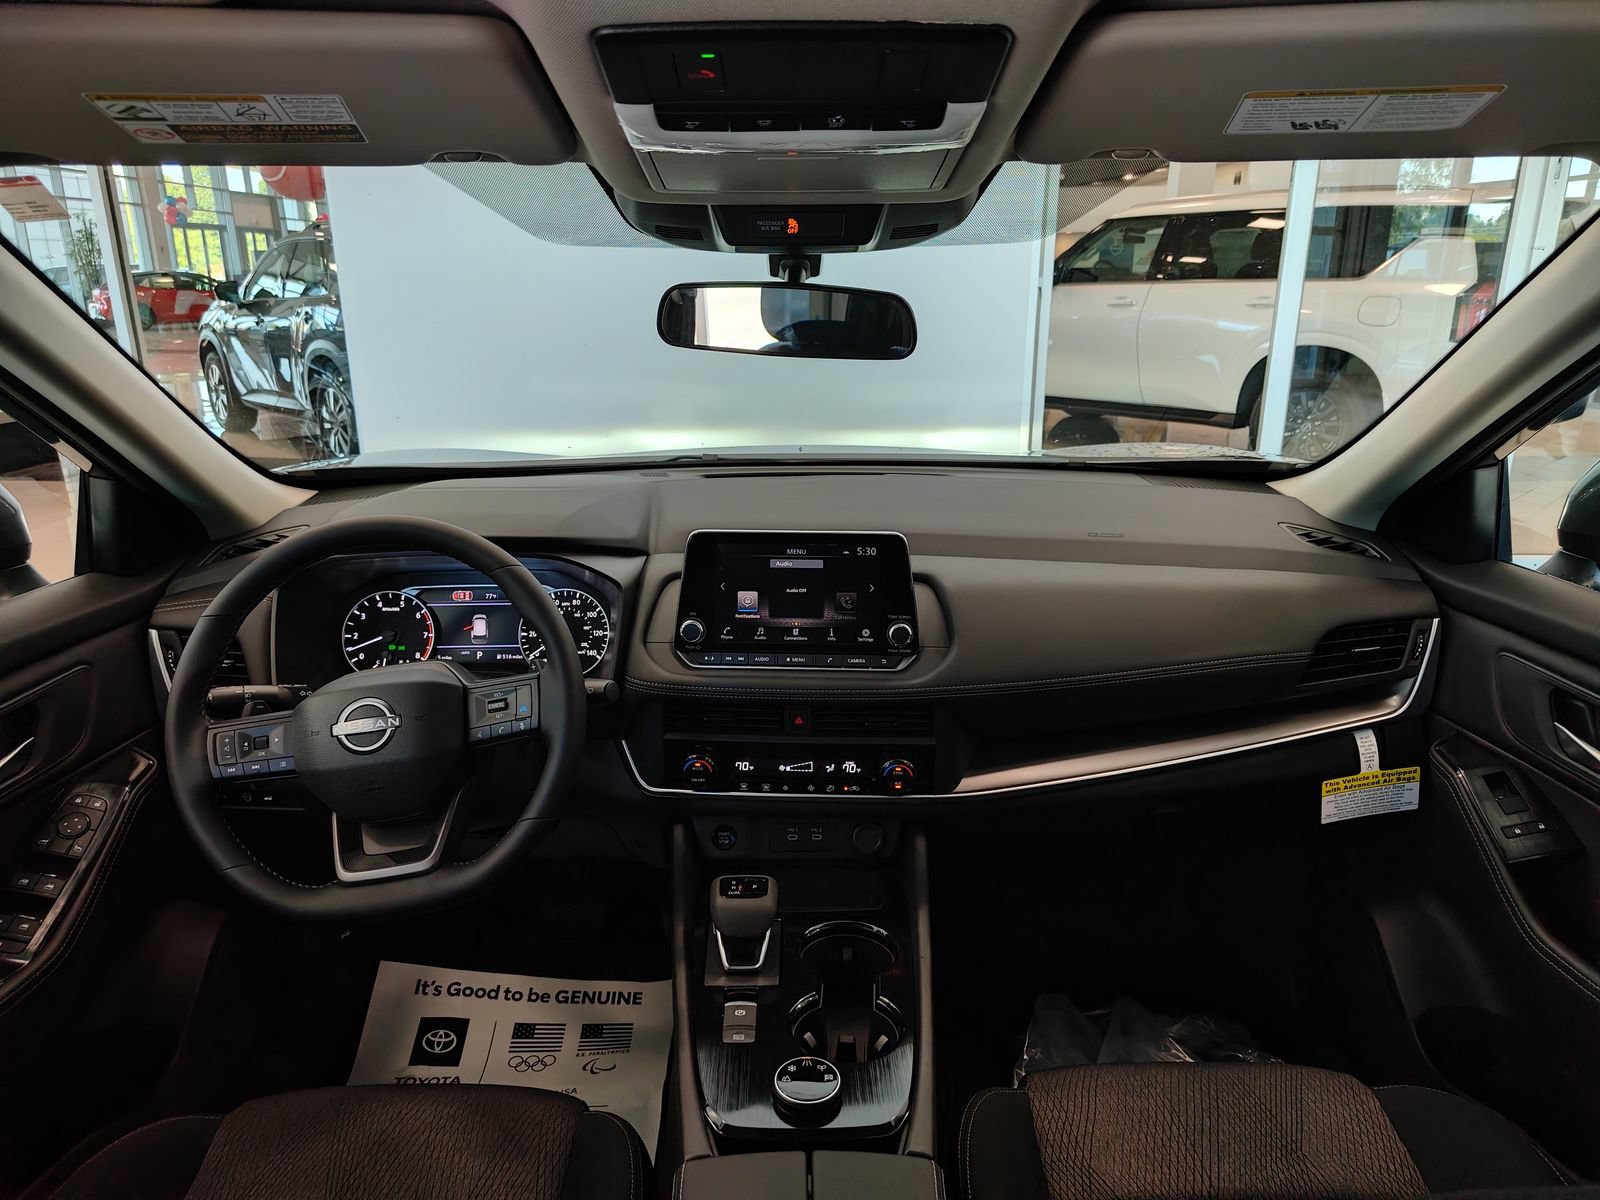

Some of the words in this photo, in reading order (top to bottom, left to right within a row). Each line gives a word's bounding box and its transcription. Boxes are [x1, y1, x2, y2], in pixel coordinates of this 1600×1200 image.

[857, 547, 877, 556] 5:30
[477, 651, 483, 659] P
[334, 717, 399, 736] NISSAN
[1342, 776, 1370, 784] Vehicle
[1381, 768, 1417, 777] Equipped
[1344, 780, 1380, 790] Advanced
[414, 978, 442, 996] It's
[446, 981, 500, 1000] Good
[504, 987, 523, 1001] to
[527, 987, 551, 1003] be
[555, 990, 643, 1005] GENUINE
[395, 1076, 461, 1084] TOYOTA
